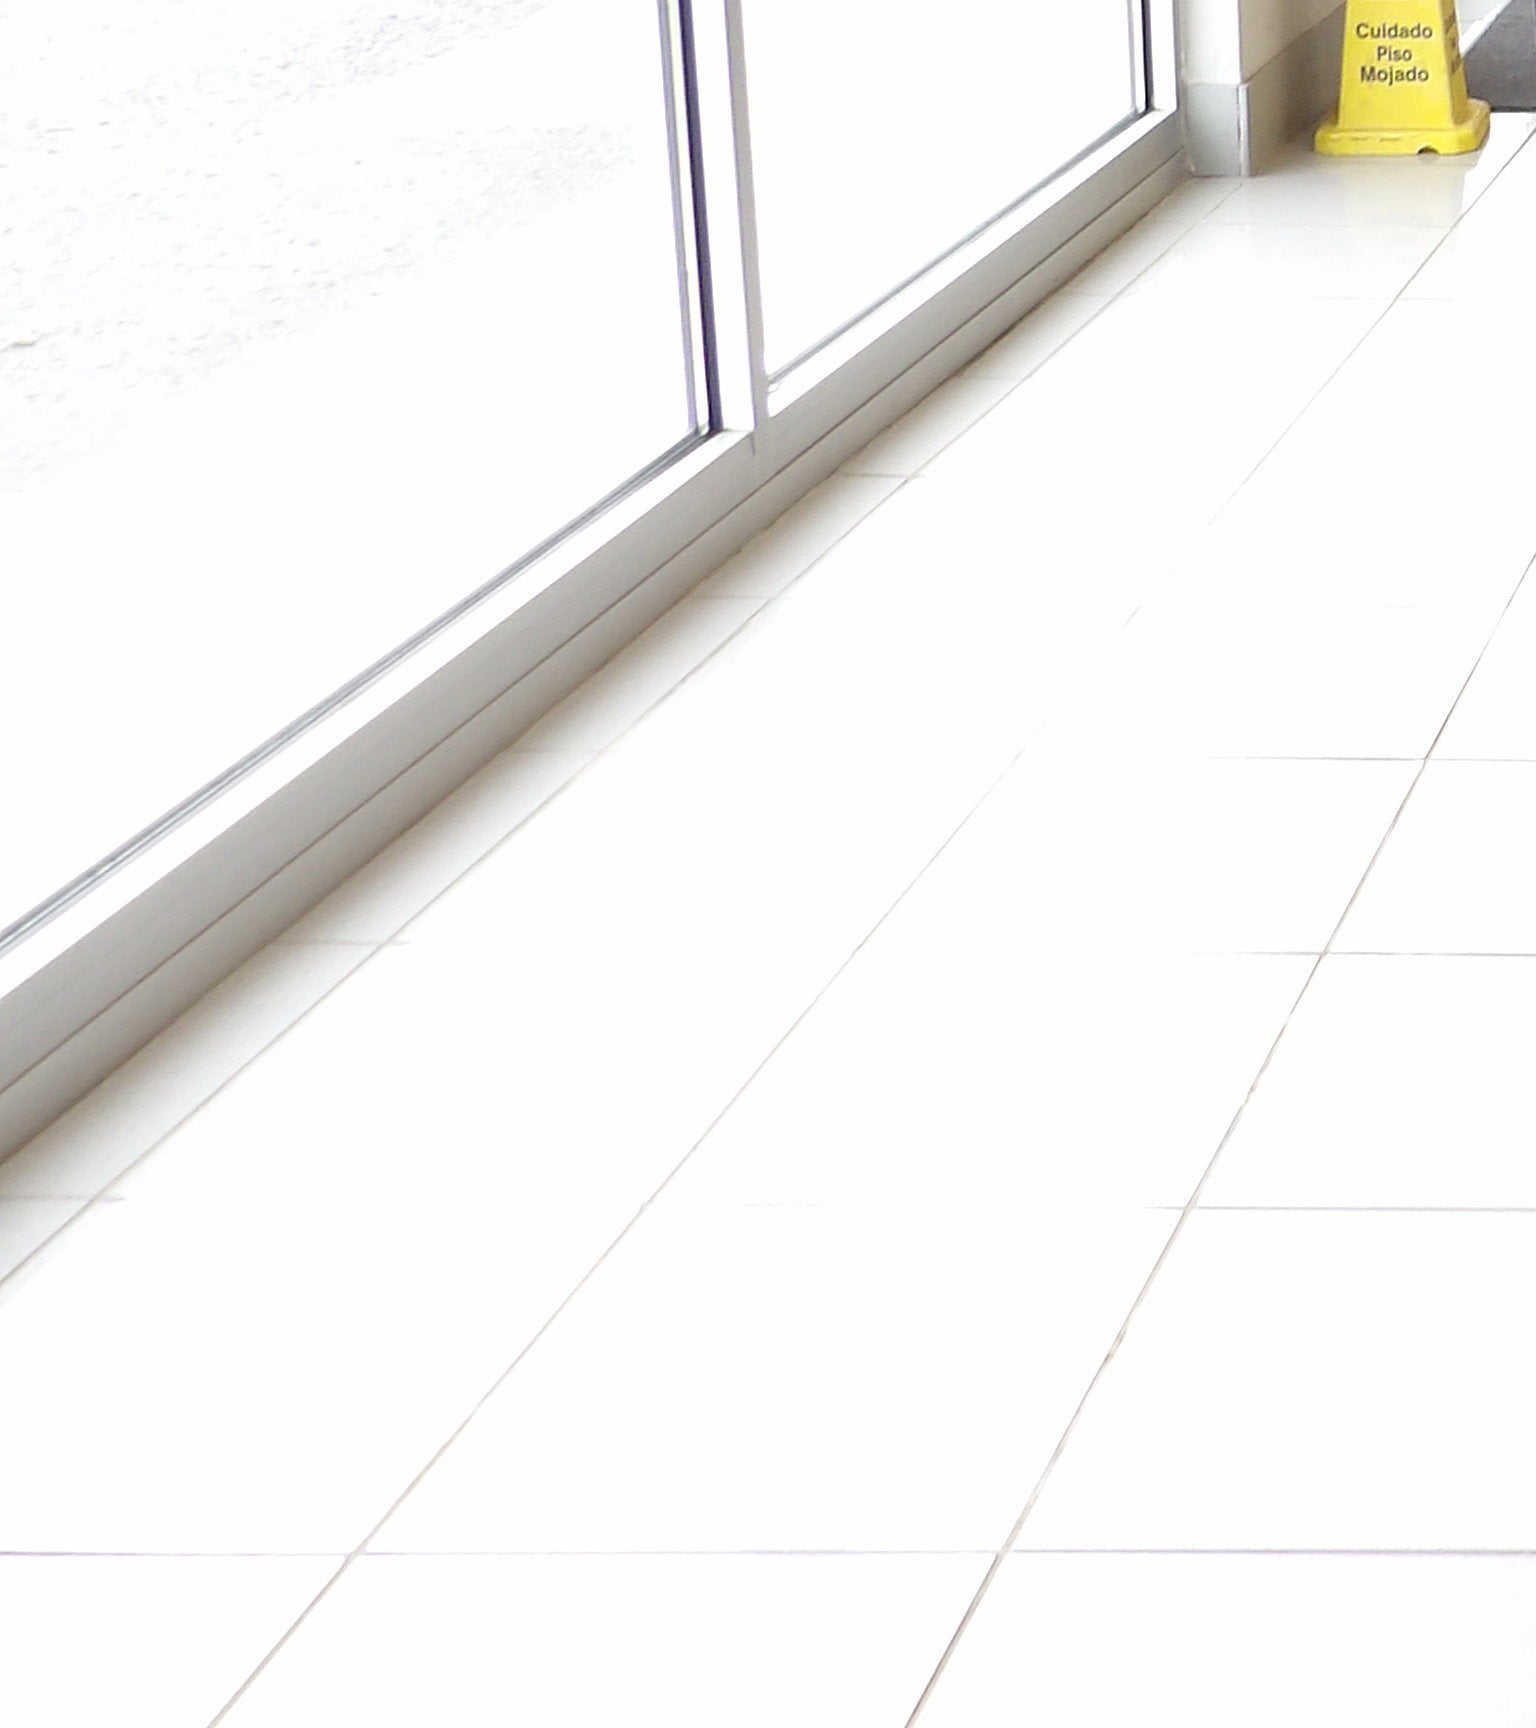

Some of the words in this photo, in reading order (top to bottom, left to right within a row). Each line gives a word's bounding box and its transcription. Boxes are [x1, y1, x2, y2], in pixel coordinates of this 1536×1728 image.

[1356, 22, 1433, 39] Cuidado
[1376, 45, 1412, 61] Piso
[1360, 65, 1429, 86] Mojado
